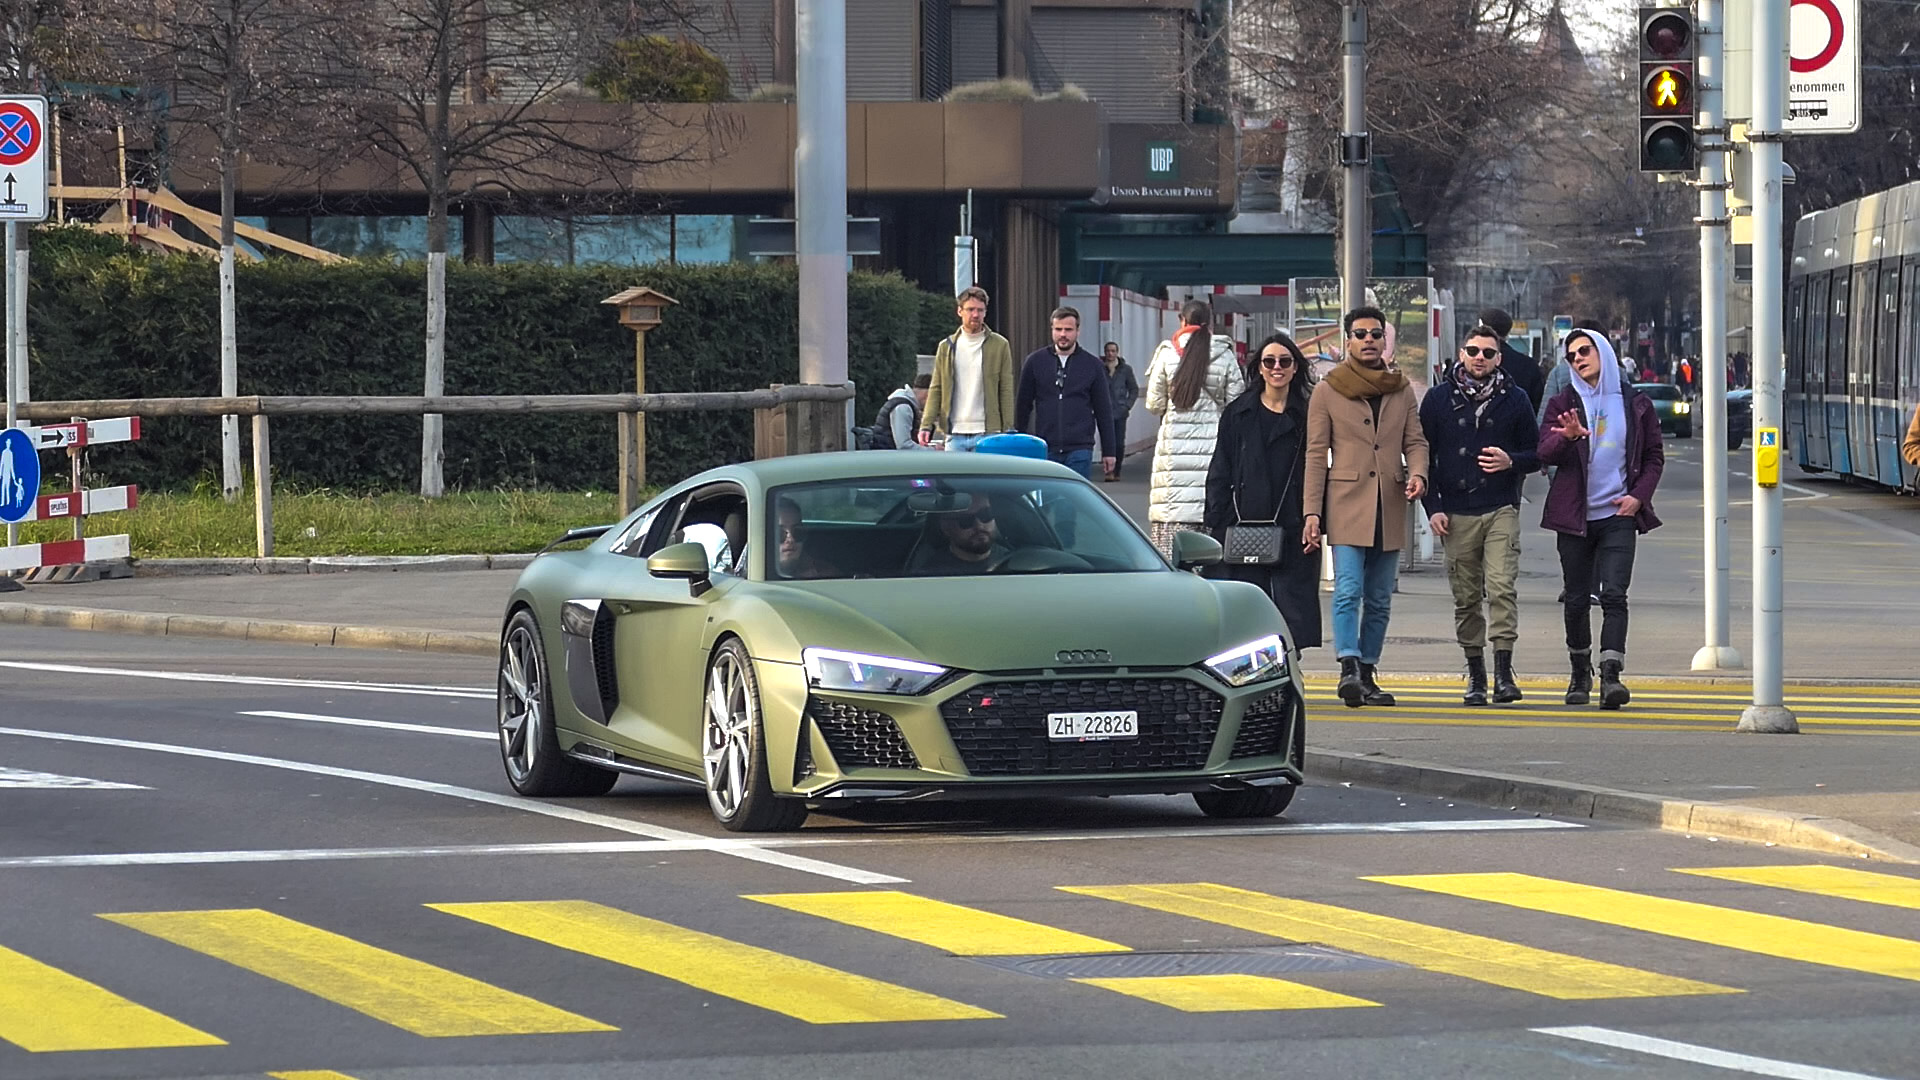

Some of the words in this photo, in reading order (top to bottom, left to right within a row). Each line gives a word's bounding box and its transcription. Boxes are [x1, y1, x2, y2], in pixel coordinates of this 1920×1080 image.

[1790, 82, 1845, 93] enommen
[1150, 147, 1174, 172] UBP
[1305, 284, 1339, 296] strauhof
[1054, 717, 1074, 735] ZH
[1084, 715, 1132, 734] 22826
